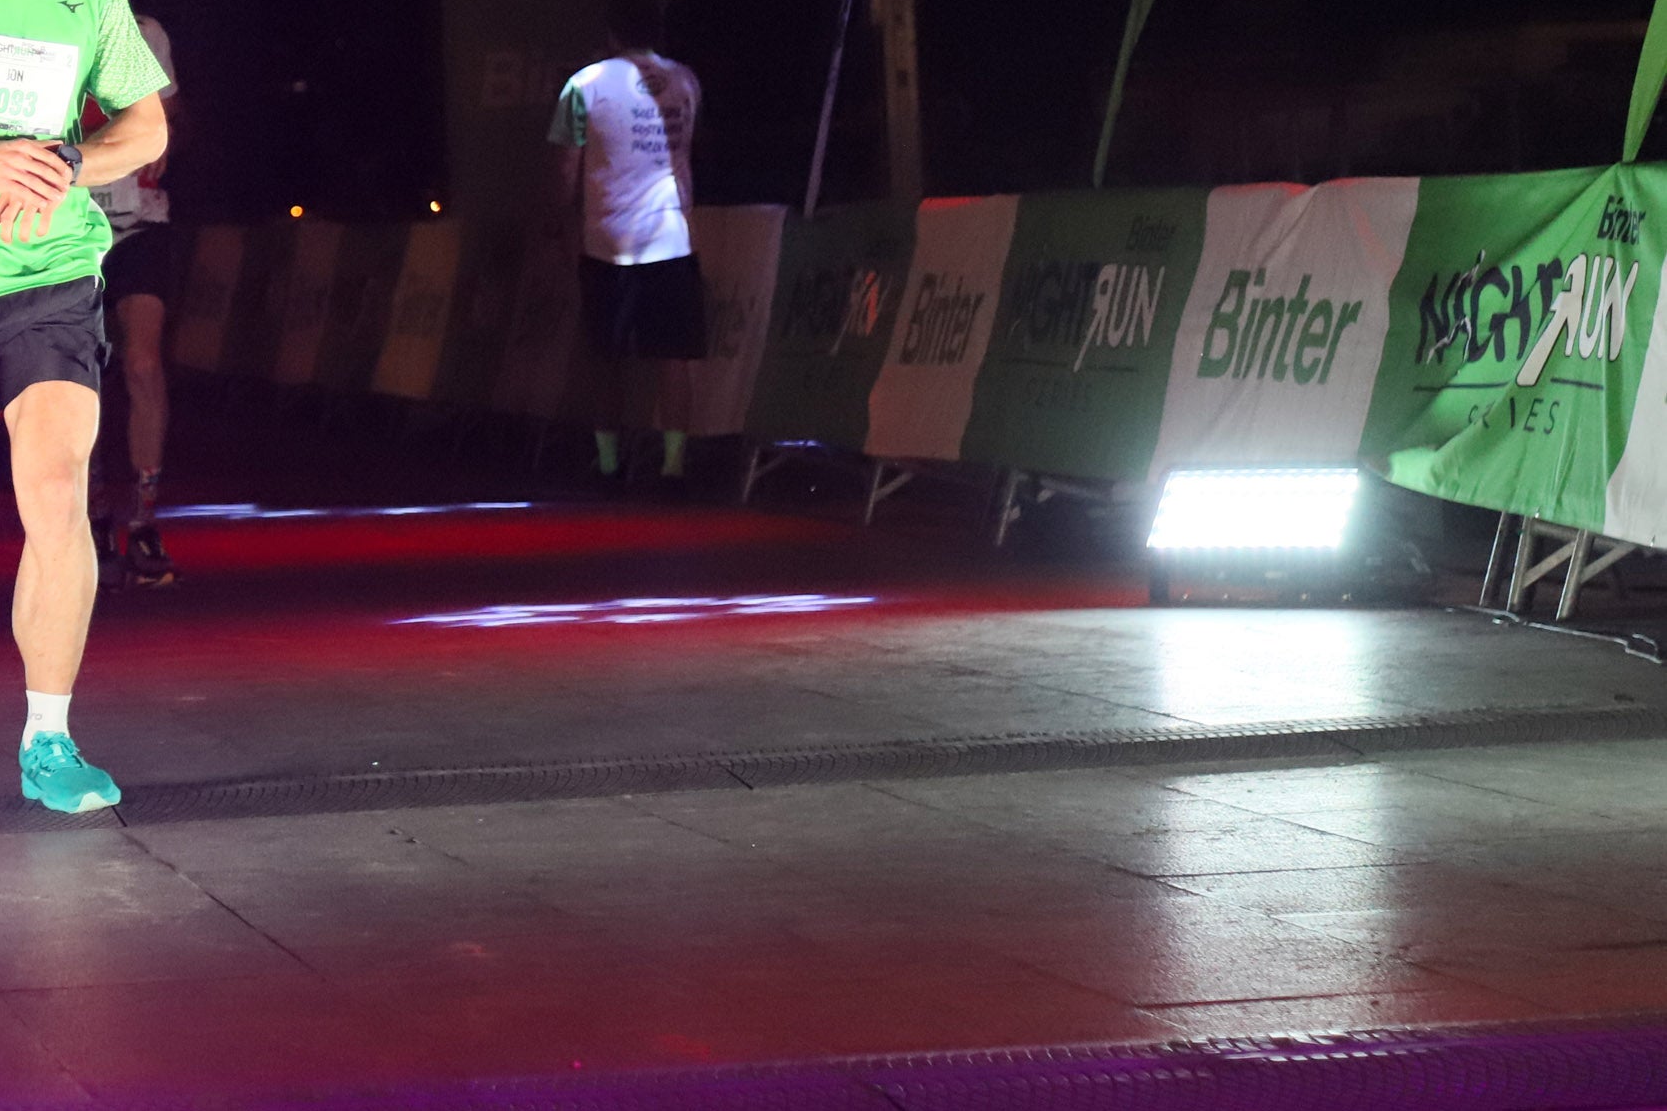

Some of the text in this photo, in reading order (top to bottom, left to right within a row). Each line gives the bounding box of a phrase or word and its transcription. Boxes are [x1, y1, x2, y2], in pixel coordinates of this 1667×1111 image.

[1597, 194, 1646, 245] Binter
[899, 272, 984, 365] Binter
[1197, 268, 1363, 385] Binter
